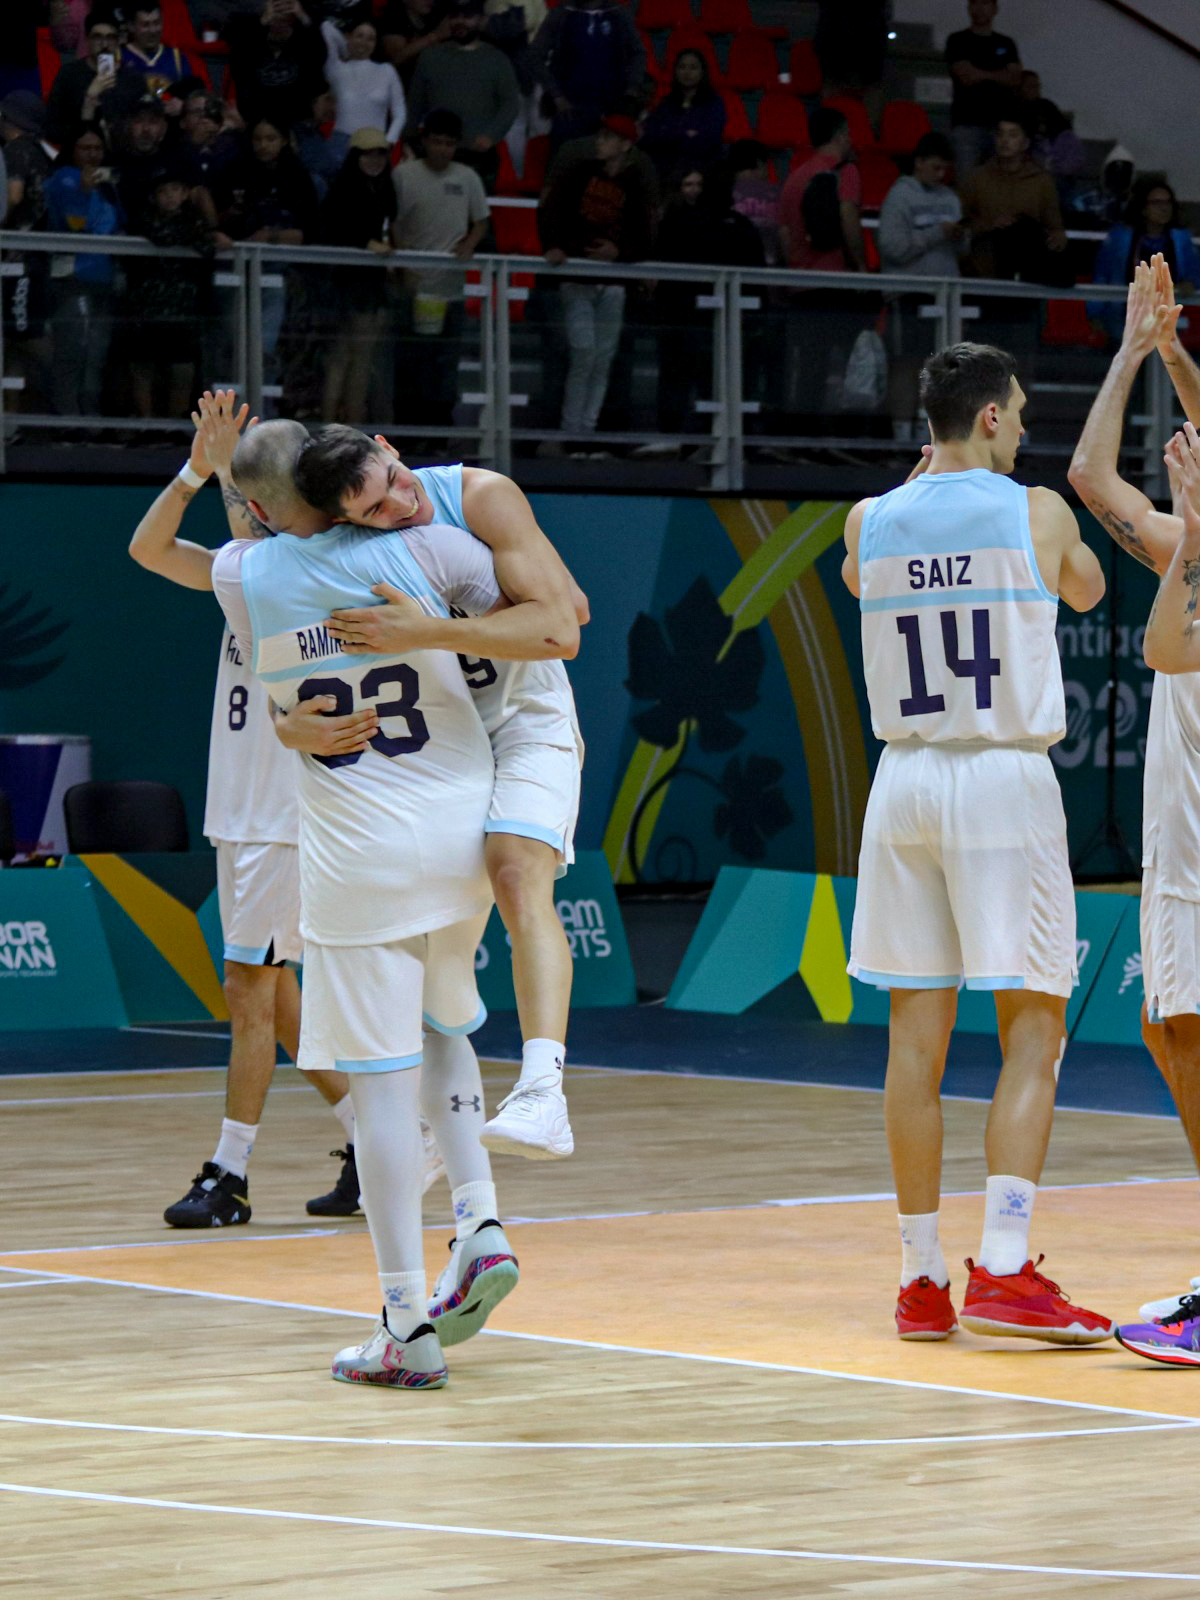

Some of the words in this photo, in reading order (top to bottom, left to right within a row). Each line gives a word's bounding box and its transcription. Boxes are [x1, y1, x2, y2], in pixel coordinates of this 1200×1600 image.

[907, 555, 972, 590] SAIZ
[896, 609, 1001, 717] 14
[229, 685, 248, 731] 8
